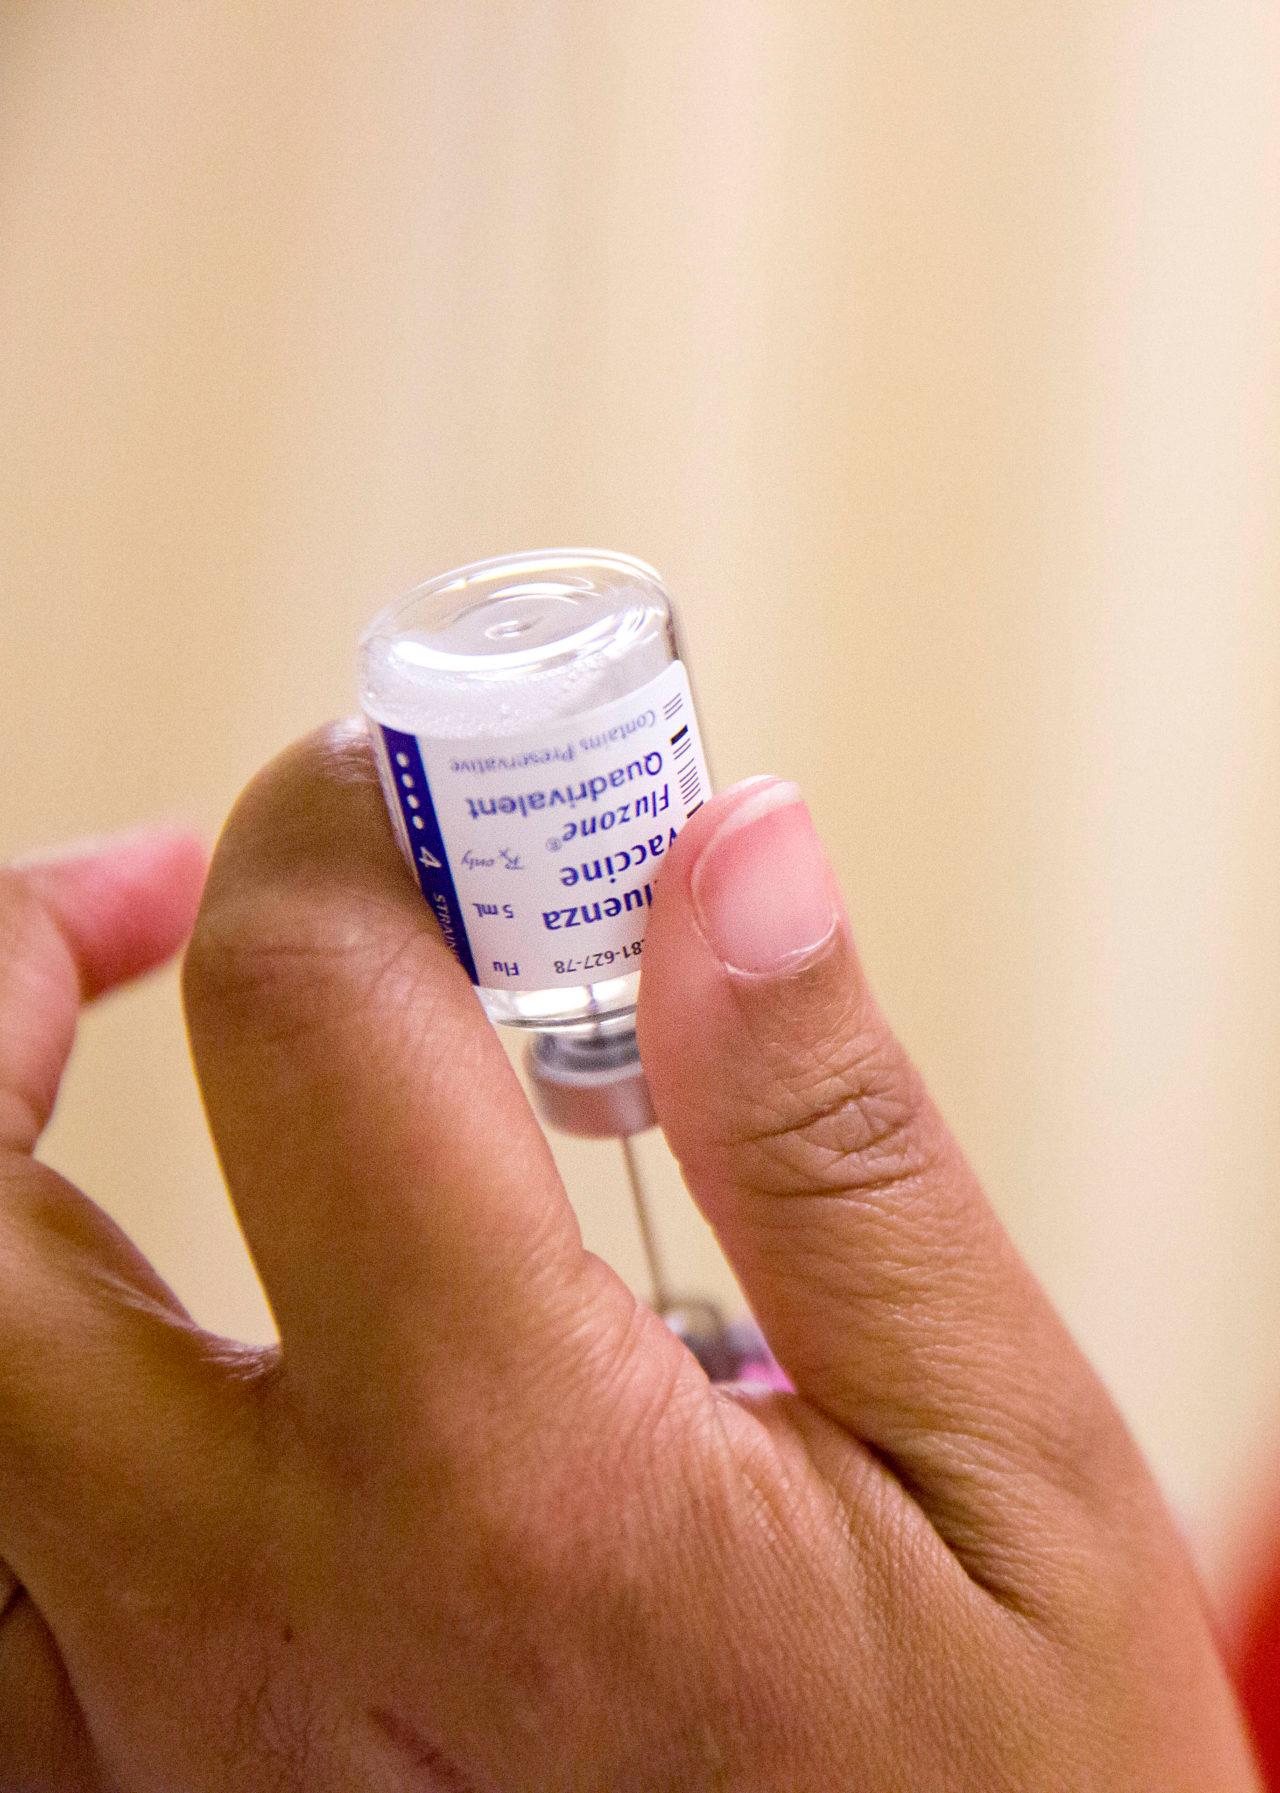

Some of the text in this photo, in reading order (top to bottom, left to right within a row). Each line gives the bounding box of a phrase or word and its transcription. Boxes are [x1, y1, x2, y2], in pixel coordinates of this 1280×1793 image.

[451, 709, 656, 774] Contains Preservative
[466, 751, 663, 819] Quadrivalent
[418, 846, 443, 868] 4
[461, 849, 495, 871] only
[472, 903, 514, 919] 5 mL
[542, 882, 655, 930] luenza
[493, 961, 519, 977] Flu
[554, 939, 644, 974] 81-627-78
